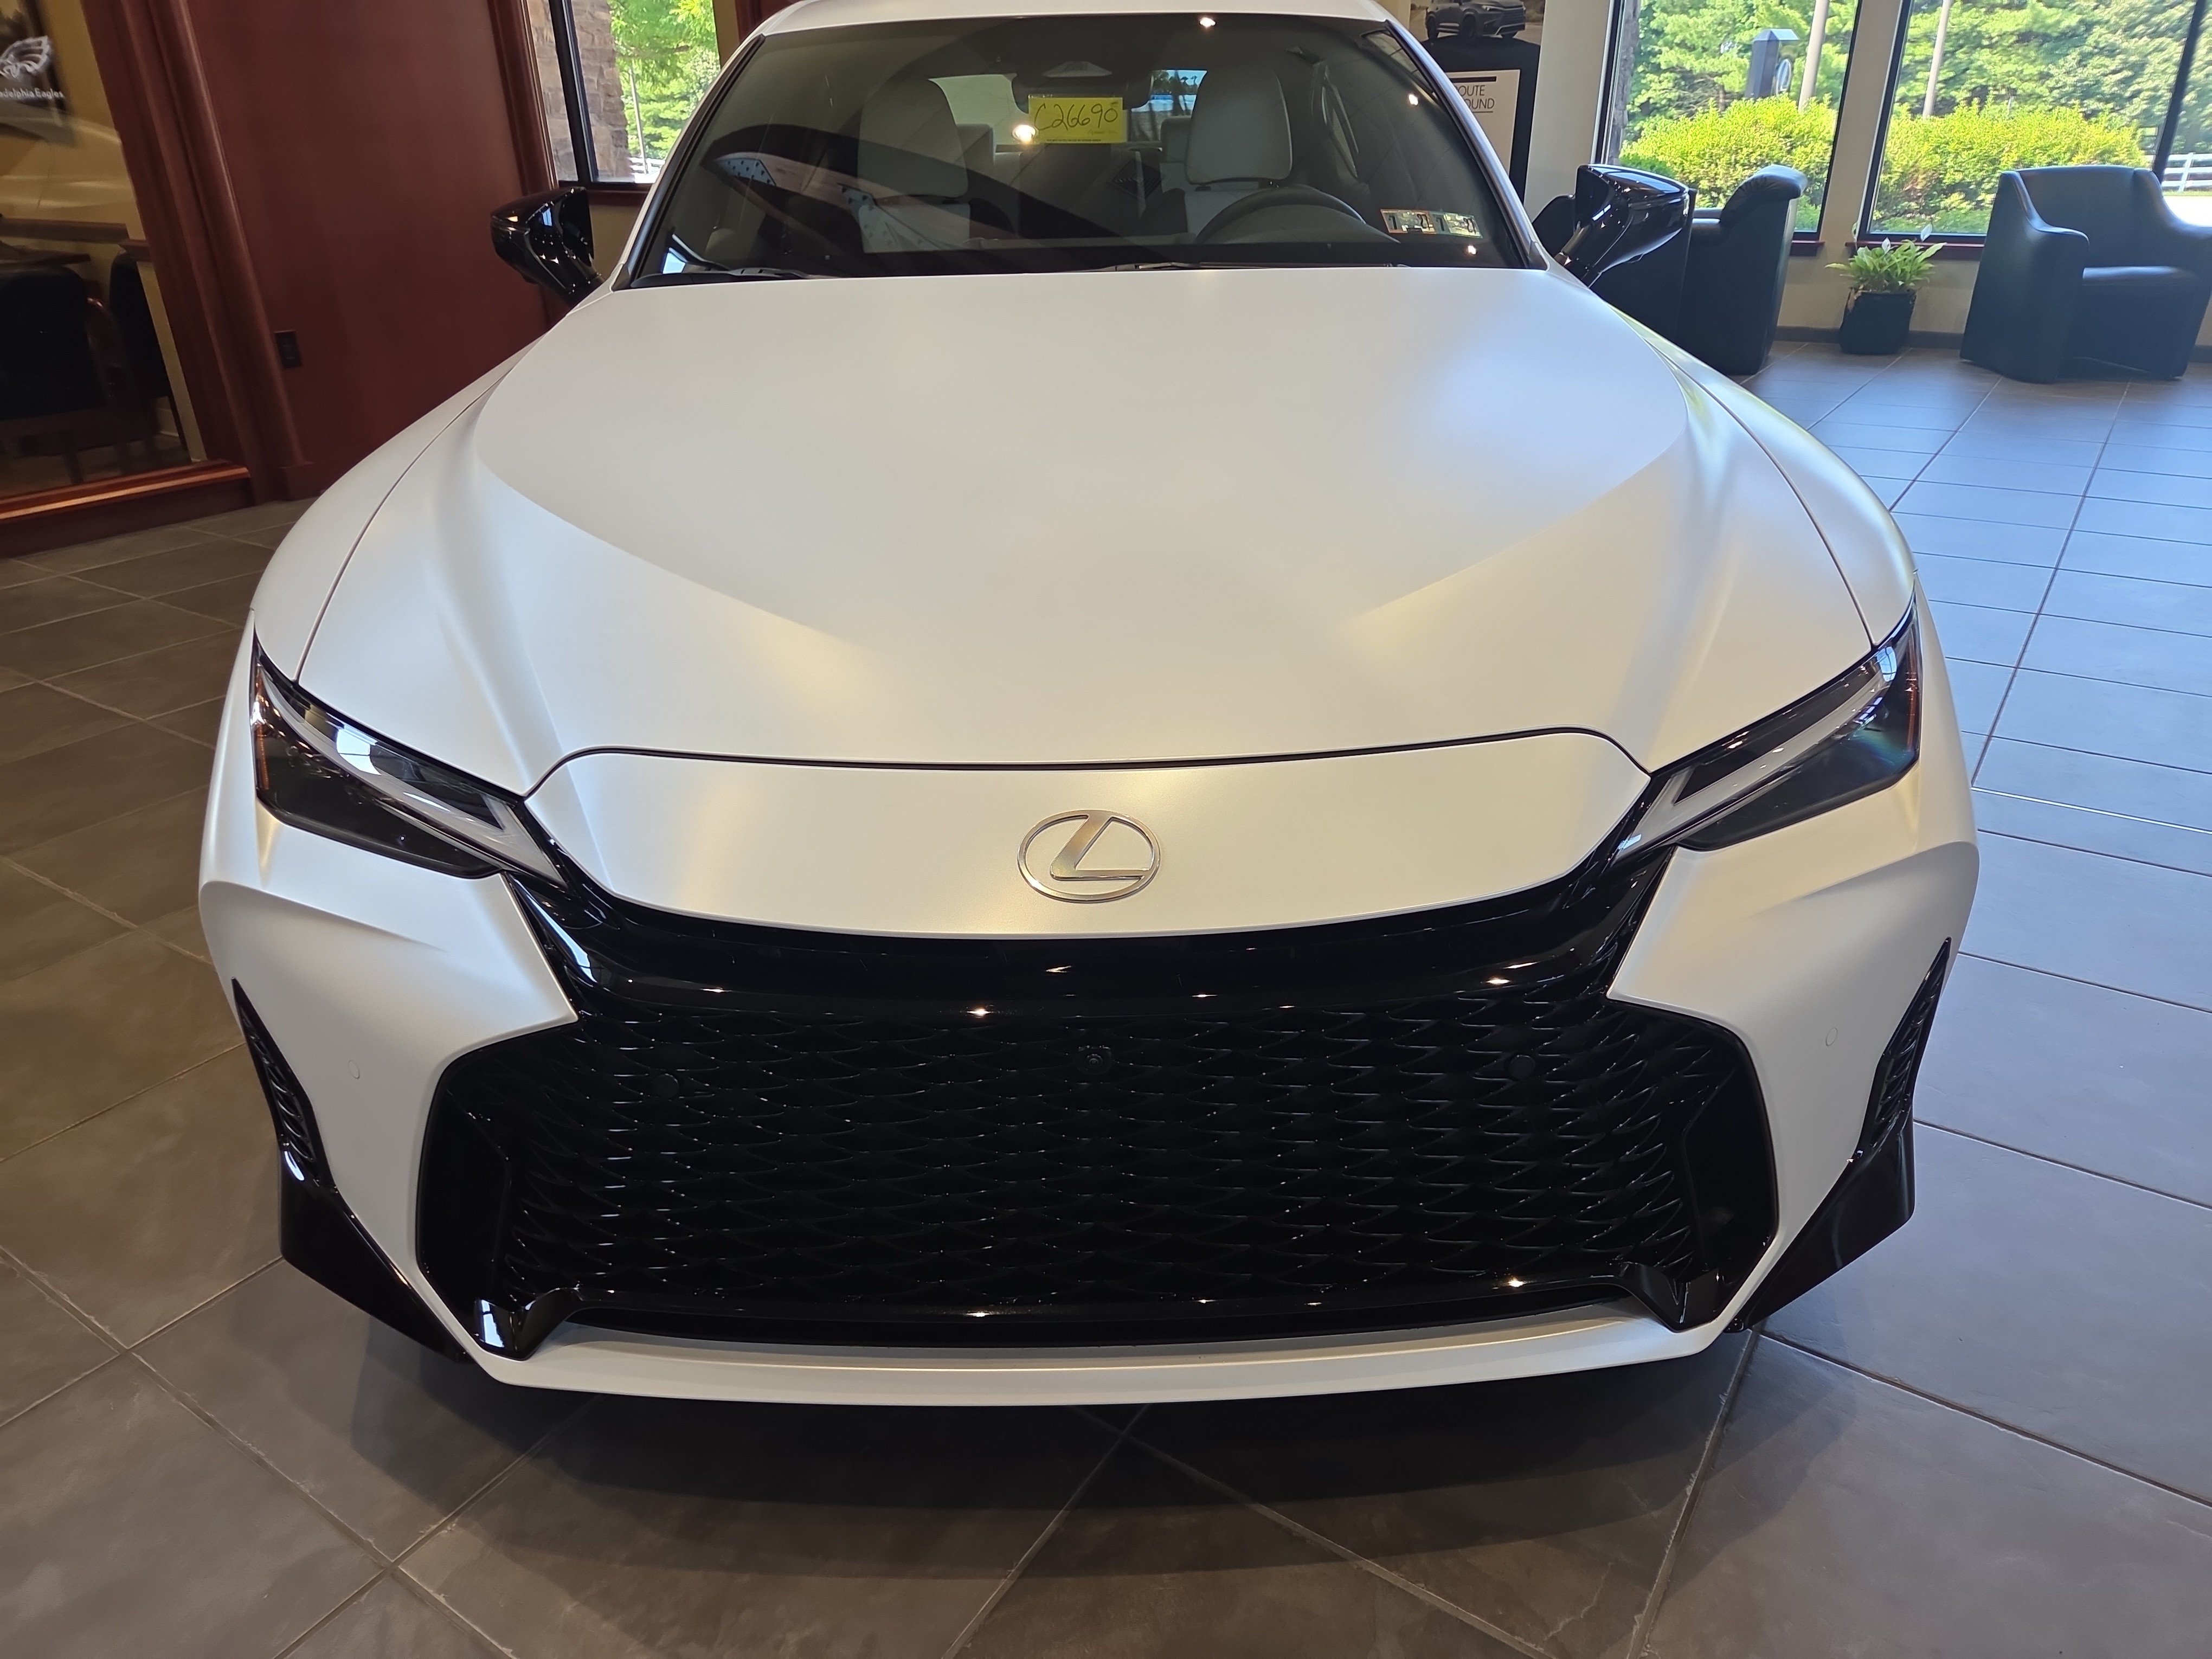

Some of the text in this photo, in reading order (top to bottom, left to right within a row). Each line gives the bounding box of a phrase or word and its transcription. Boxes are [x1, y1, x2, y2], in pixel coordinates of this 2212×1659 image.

[34, 87, 65, 100] Eagles
[1454, 85, 1486, 97] OUTE
[1034, 102, 1118, 131] C26690
